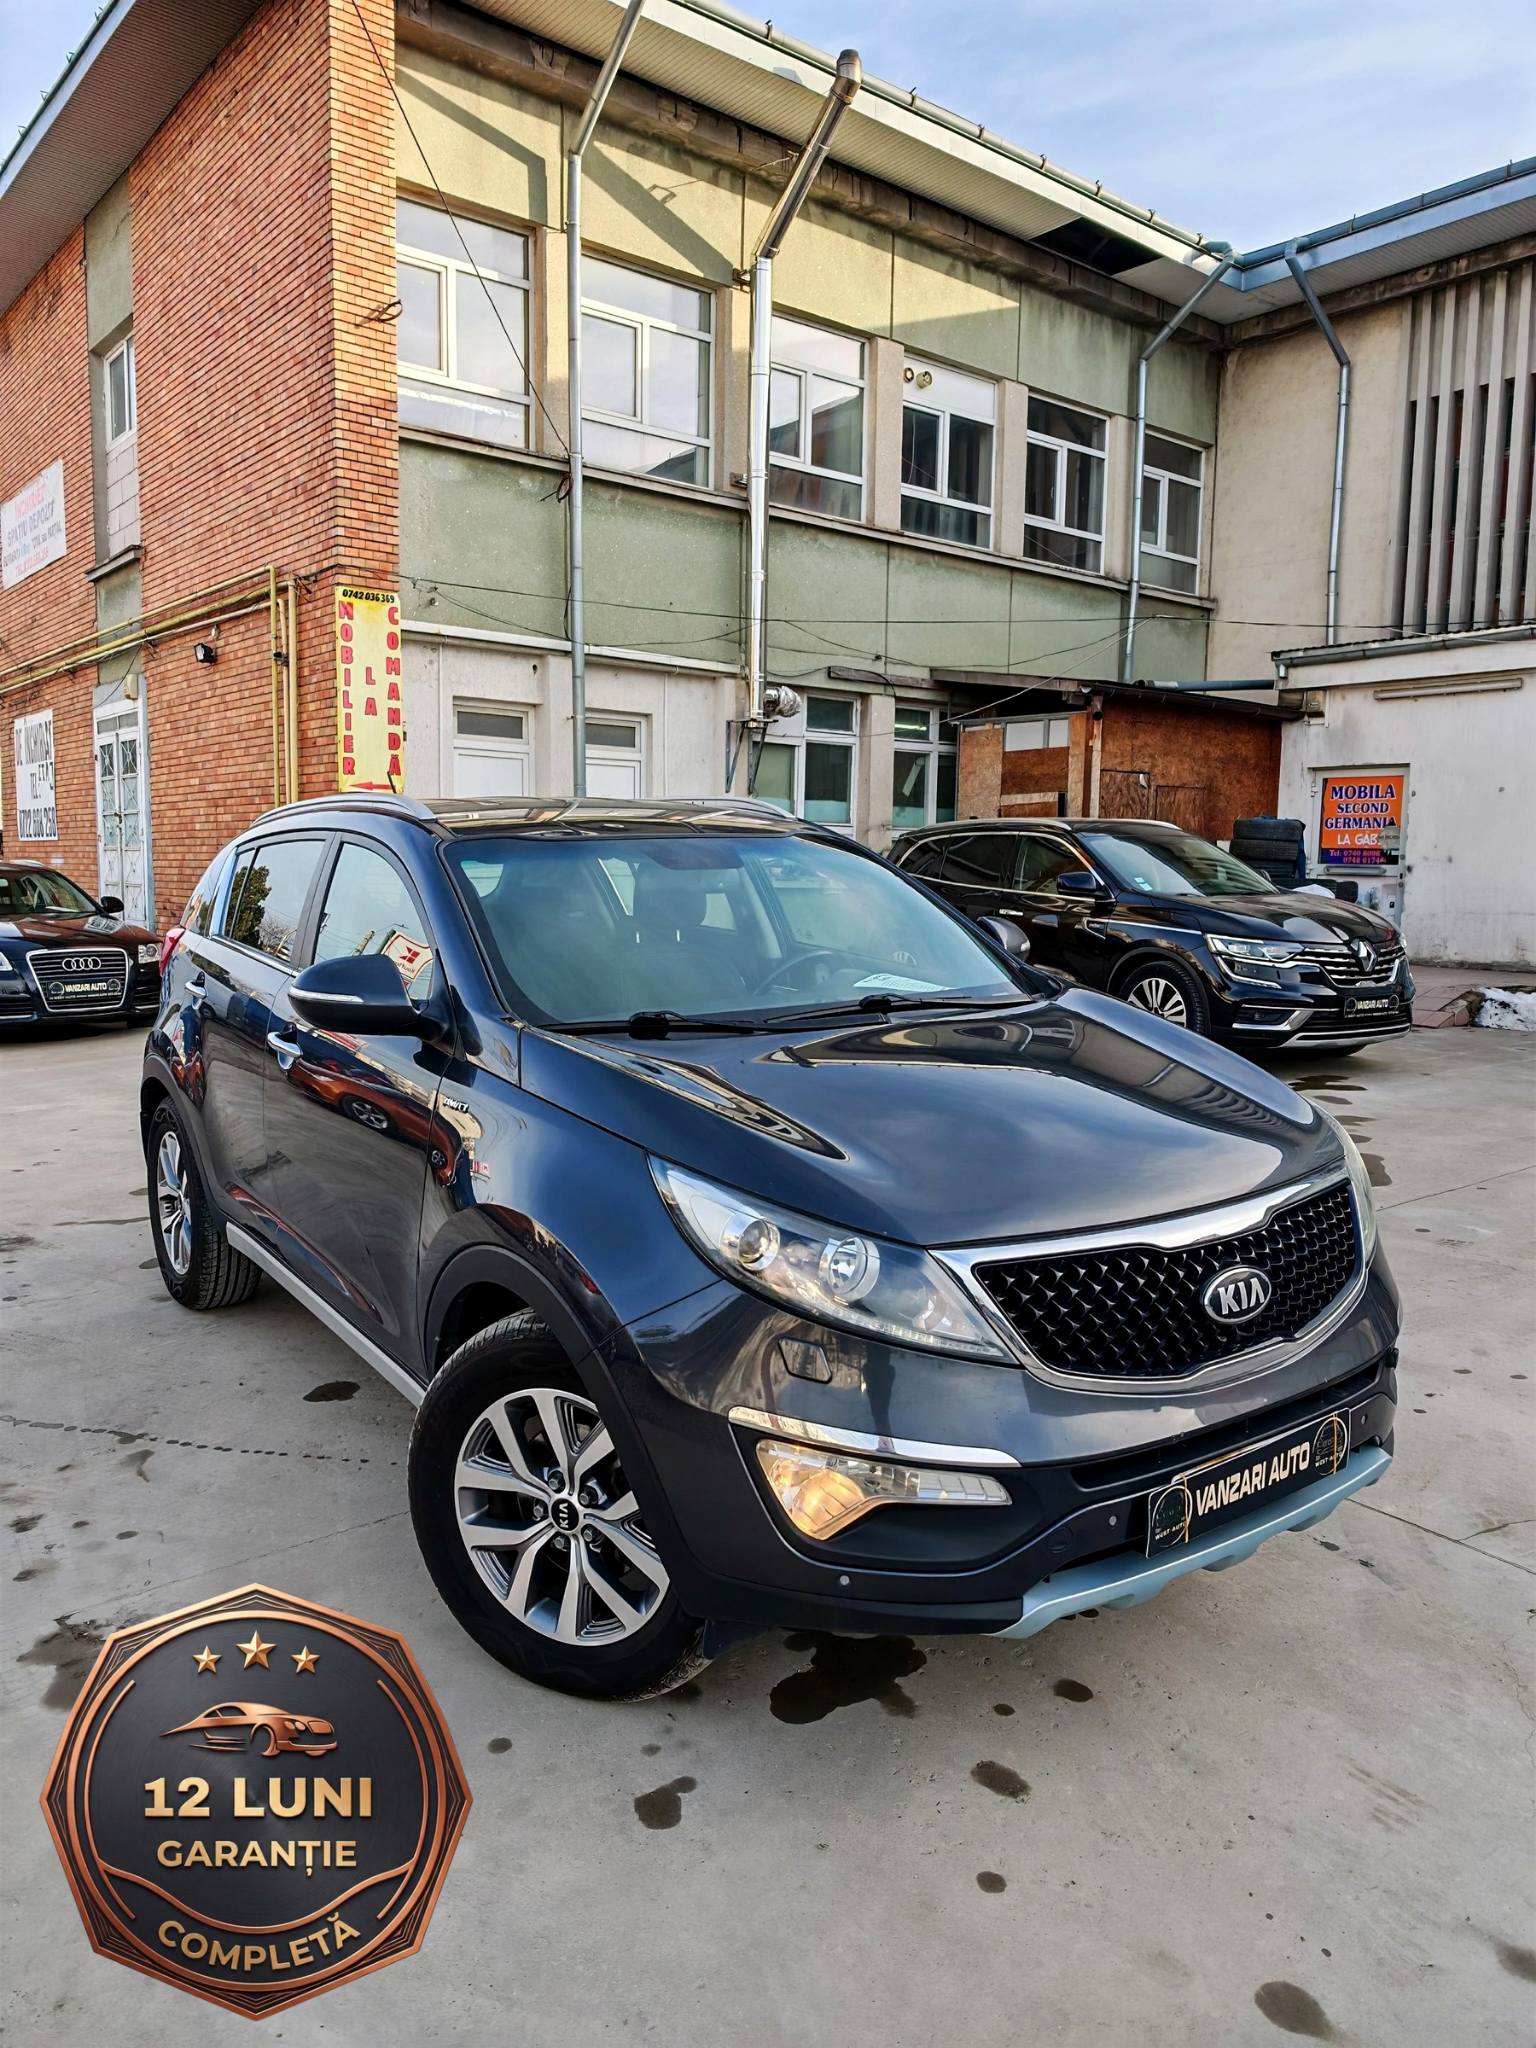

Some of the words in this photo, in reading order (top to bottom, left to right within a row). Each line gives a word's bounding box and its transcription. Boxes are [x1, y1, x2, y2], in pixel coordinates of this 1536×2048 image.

[342, 589, 363, 600] 0742
[364, 592, 380, 601] 036
[381, 594, 395, 603] 369
[364, 666, 378, 716] LA
[1330, 784, 1396, 800] MOBILA
[1337, 802, 1390, 814] SECOND
[1337, 833, 1351, 845] LA
[91, 982, 107, 991] AUTO
[1217, 1277, 1265, 1315] KIA
[1196, 1461, 1267, 1516] VANZARI
[1268, 1441, 1311, 1486] AUTO
[559, 1502, 569, 1529] KIA
